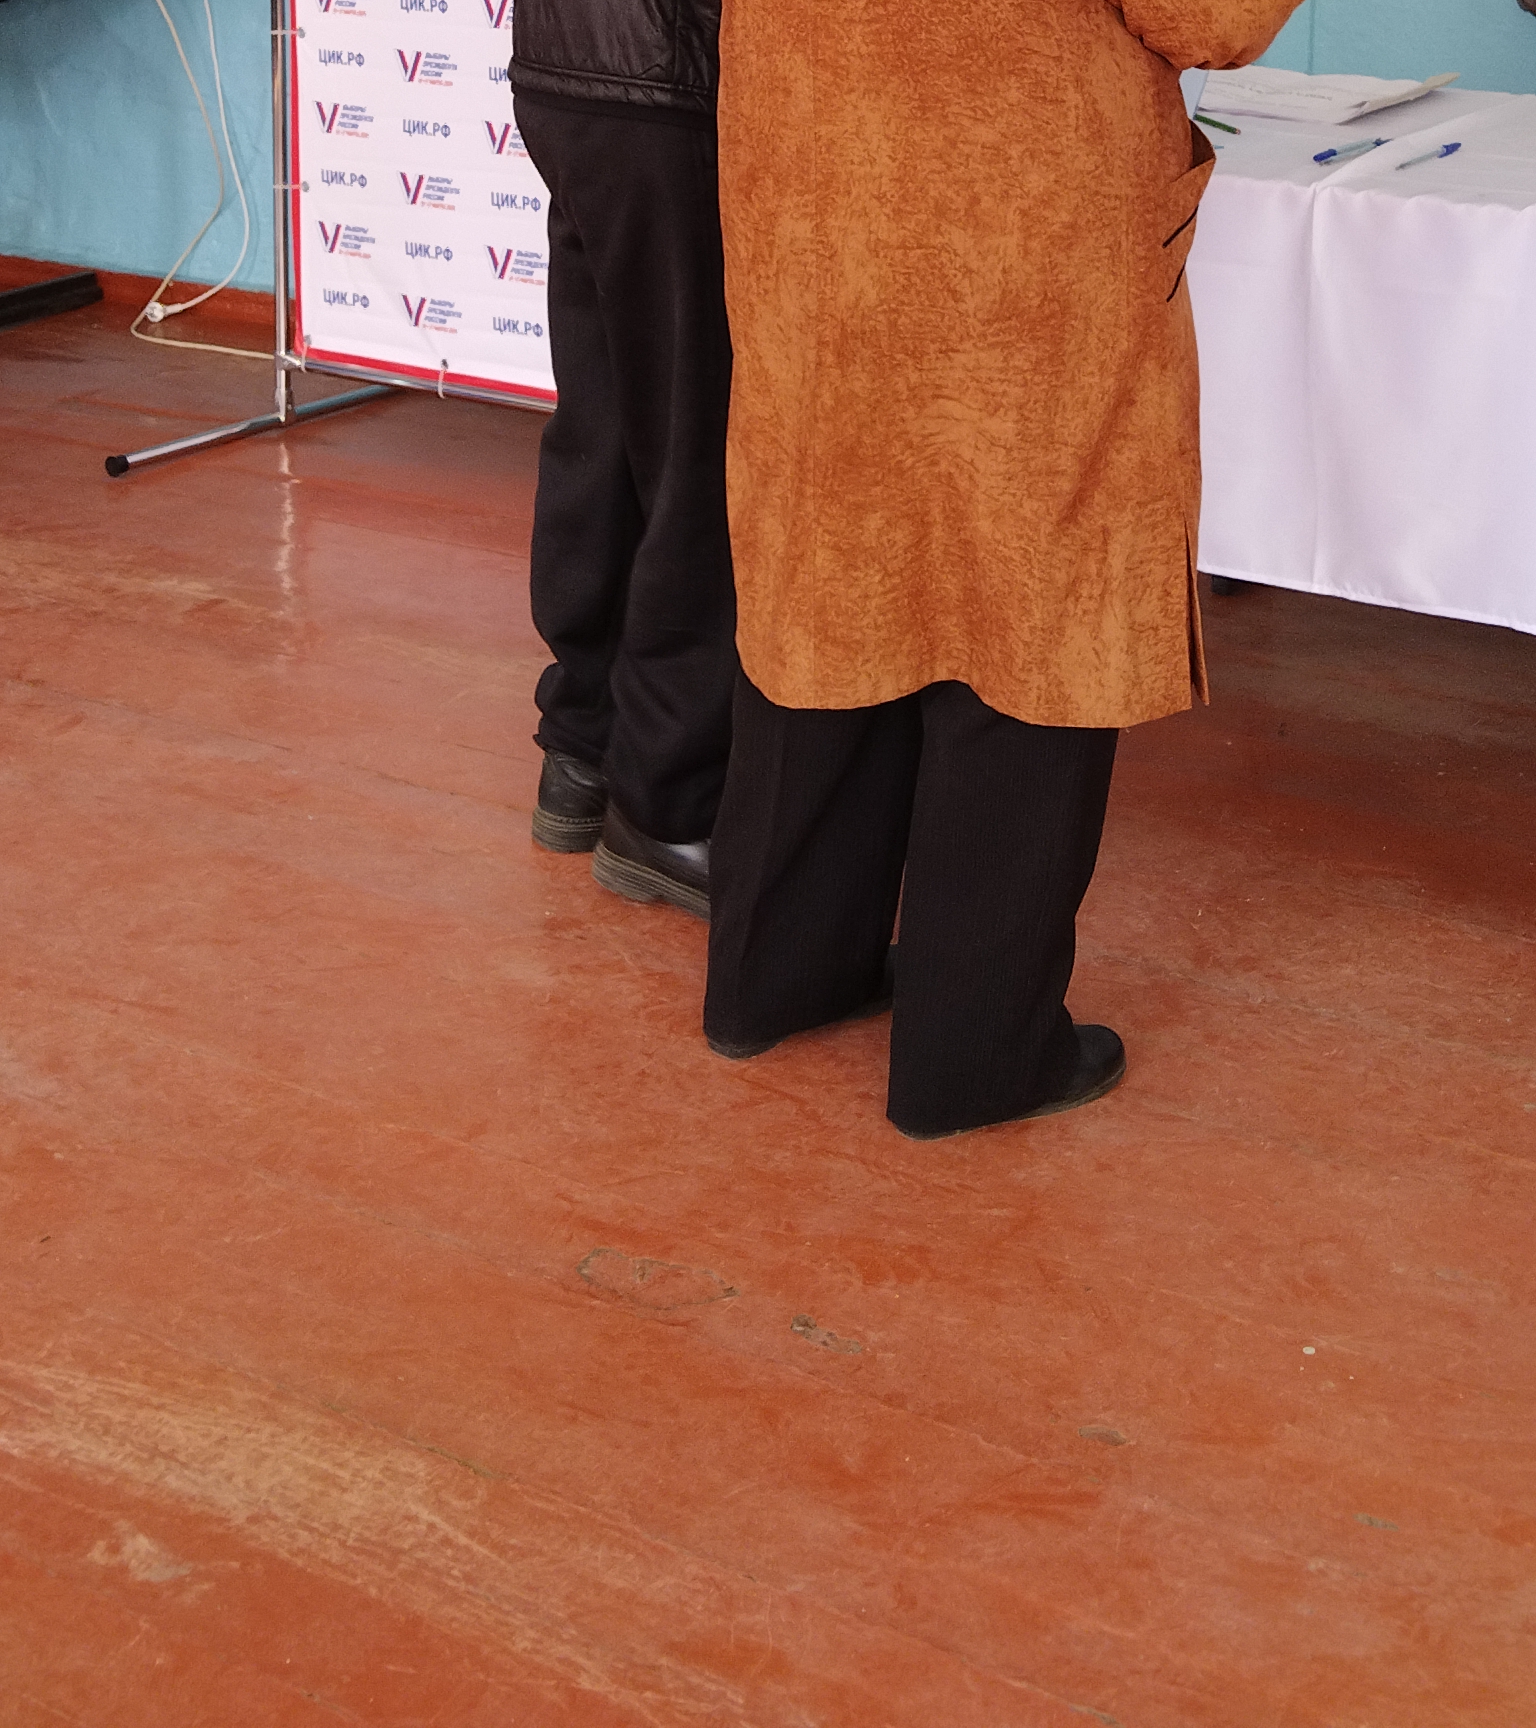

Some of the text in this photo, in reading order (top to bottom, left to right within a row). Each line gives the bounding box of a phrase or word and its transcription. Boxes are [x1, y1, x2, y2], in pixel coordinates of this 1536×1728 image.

[318, 49, 364, 66] ЦИК.РФ
[403, 119, 451, 138] ЦИК.РФ
[321, 169, 367, 188] ЦИК.РФ
[491, 192, 541, 211] ЦИК.РФ
[405, 241, 453, 261] ЦИК.РФ
[323, 289, 369, 308] ЦИК.РФ
[493, 317, 543, 337] ЦИК.РФ
